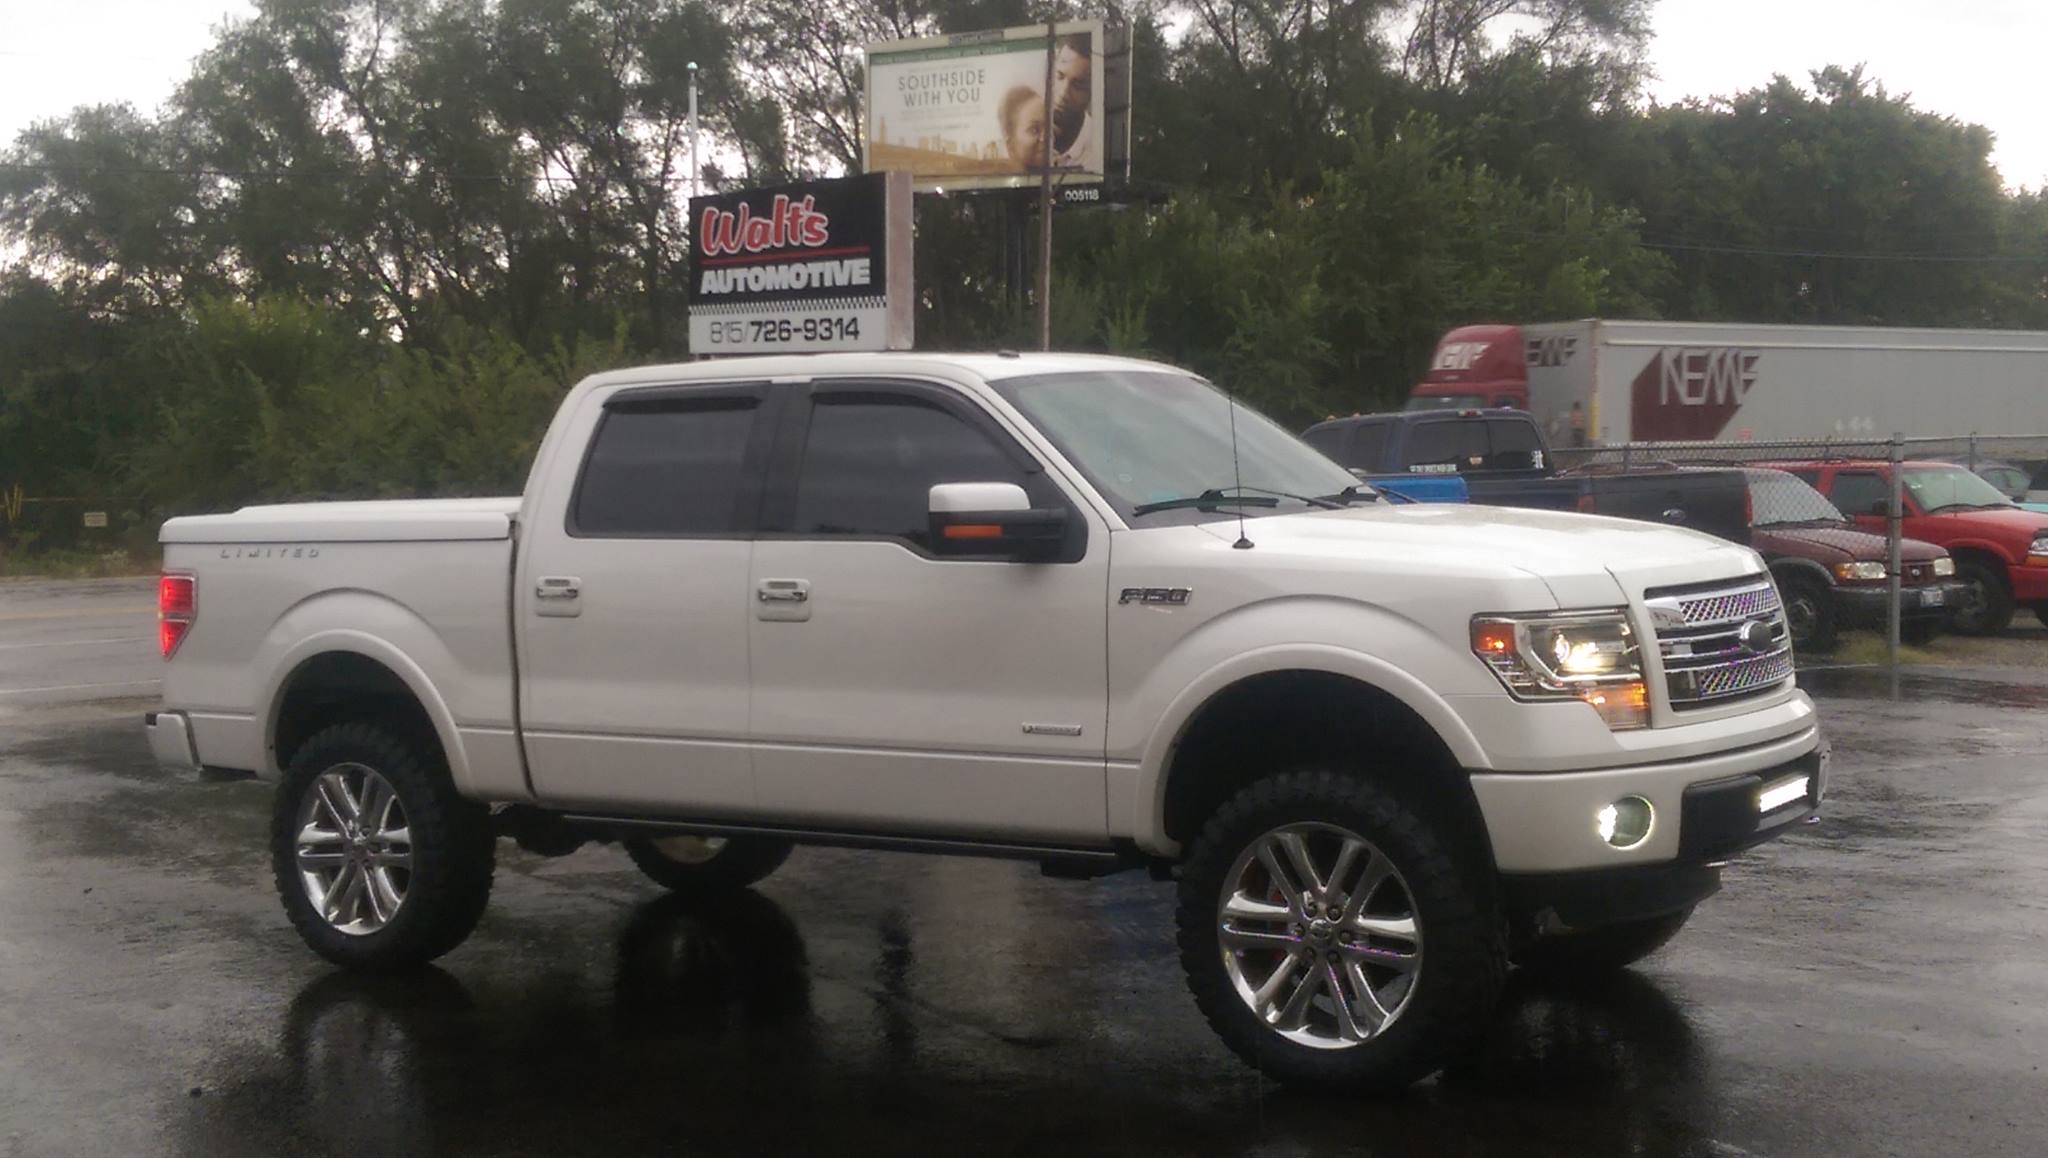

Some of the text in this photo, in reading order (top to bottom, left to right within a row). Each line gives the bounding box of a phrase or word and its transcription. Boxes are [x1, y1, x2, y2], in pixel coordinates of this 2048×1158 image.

[898, 69, 985, 91] SOUTHSIDE
[904, 87, 980, 107] WITH YOU
[702, 194, 828, 256] Walt's
[701, 258, 871, 294] AUTOMOTIVE
[220, 548, 320, 559] LIMITED
